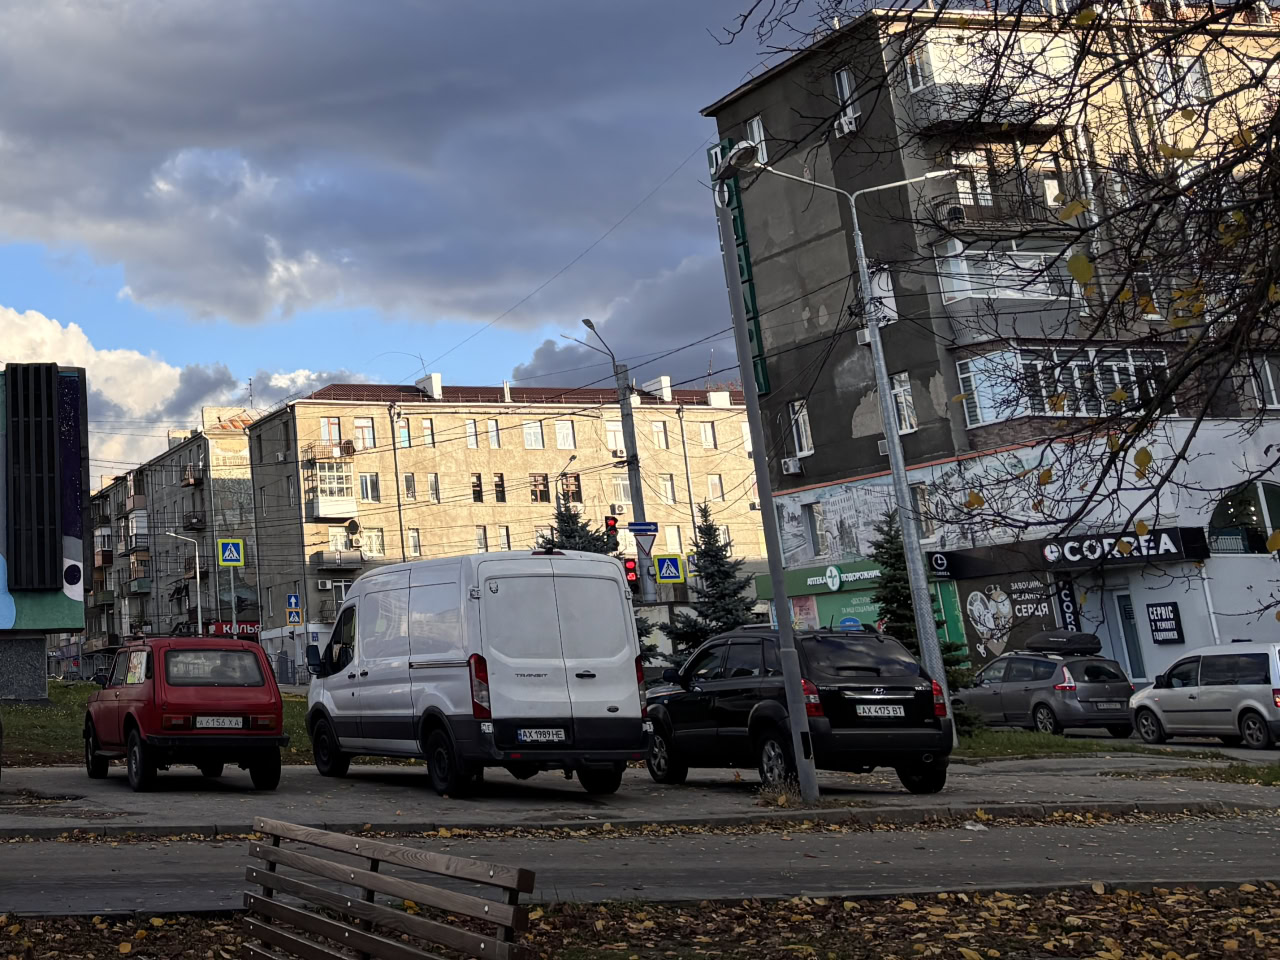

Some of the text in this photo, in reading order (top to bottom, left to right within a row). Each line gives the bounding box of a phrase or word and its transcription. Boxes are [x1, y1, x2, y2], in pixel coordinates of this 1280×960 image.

[807, 576, 827, 586] АПТЕКА
[1149, 605, 1174, 620] СЕРВІС
[862, 706, 902, 715] AX 4175 BT
[522, 730, 563, 739] AX 1989 HE
